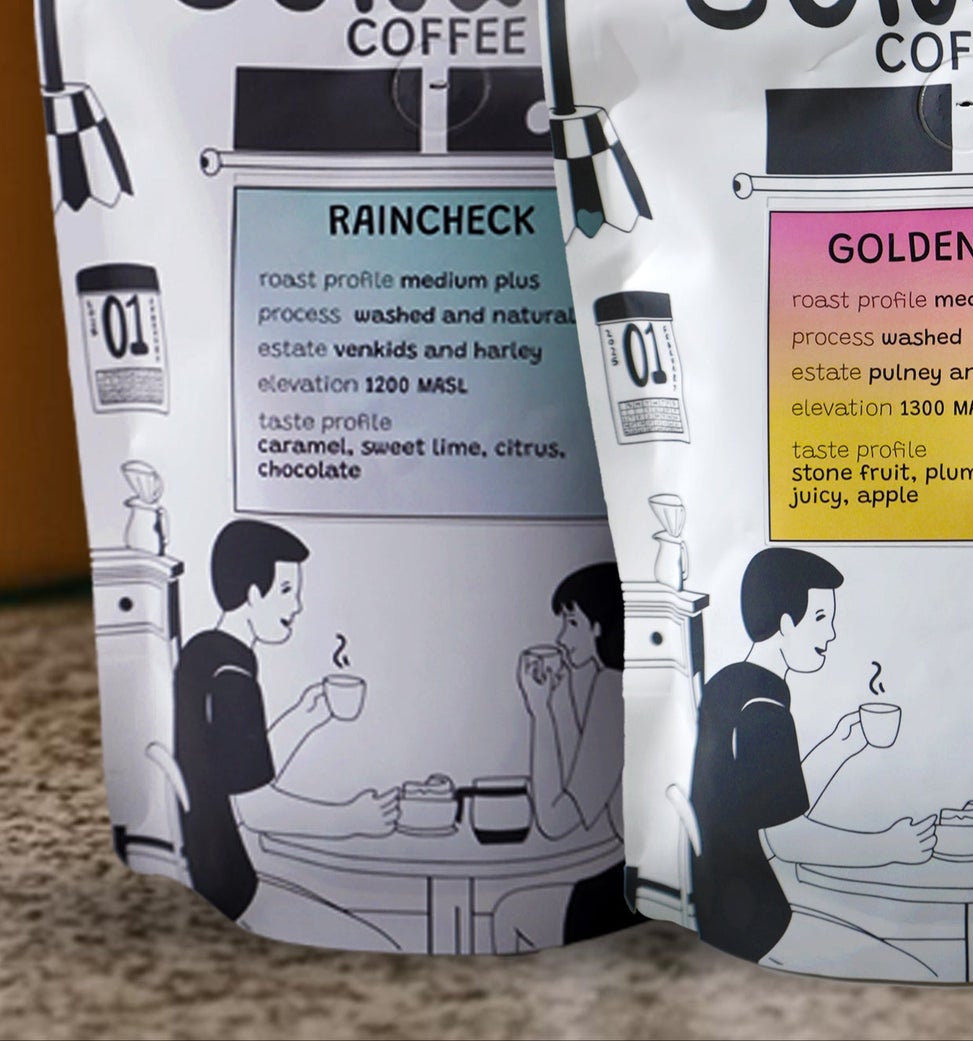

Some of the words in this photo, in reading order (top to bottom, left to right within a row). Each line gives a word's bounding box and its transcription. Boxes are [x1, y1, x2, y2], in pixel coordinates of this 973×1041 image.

[347, 17, 526, 57] COFFEE
[329, 204, 535, 236] RAINCHECK
[259, 271, 316, 289] roast
[324, 271, 394, 291] profile
[400, 272, 487, 289] medium
[494, 272, 540, 291] plus
[793, 291, 849, 308] roast
[858, 291, 927, 312] profile
[102, 294, 149, 359] 01
[258, 306, 341, 326] process
[354, 307, 435, 324] washed
[442, 307, 484, 323] and
[793, 329, 874, 349] process
[882, 328, 962, 345] washed
[258, 341, 327, 358] estate
[333, 341, 417, 359] venkids
[424, 342, 466, 359] and
[474, 342, 542, 364] harley
[622, 322, 667, 388] 01
[258, 375, 358, 393] elevation
[365, 376, 409, 393] 1200
[418, 376, 468, 393] MASL
[792, 363, 861, 381] estate
[869, 363, 942, 386] pulney
[792, 400, 892, 416] elevation
[901, 400, 944, 416] 1300
[259, 414, 314, 430] taste
[322, 412, 392, 434] profile
[258, 438, 353, 456] caramel,
[361, 439, 424, 456] sweet
[432, 439, 487, 457] lime,
[495, 439, 566, 459] citrus,
[793, 442, 848, 459] taste
[857, 441, 927, 462] profile
[258, 461, 361, 479] chocolate
[793, 464, 852, 481] stone
[860, 464, 917, 482] fruit,
[789, 488, 848, 508] juicy,
[857, 487, 918, 508] apple
